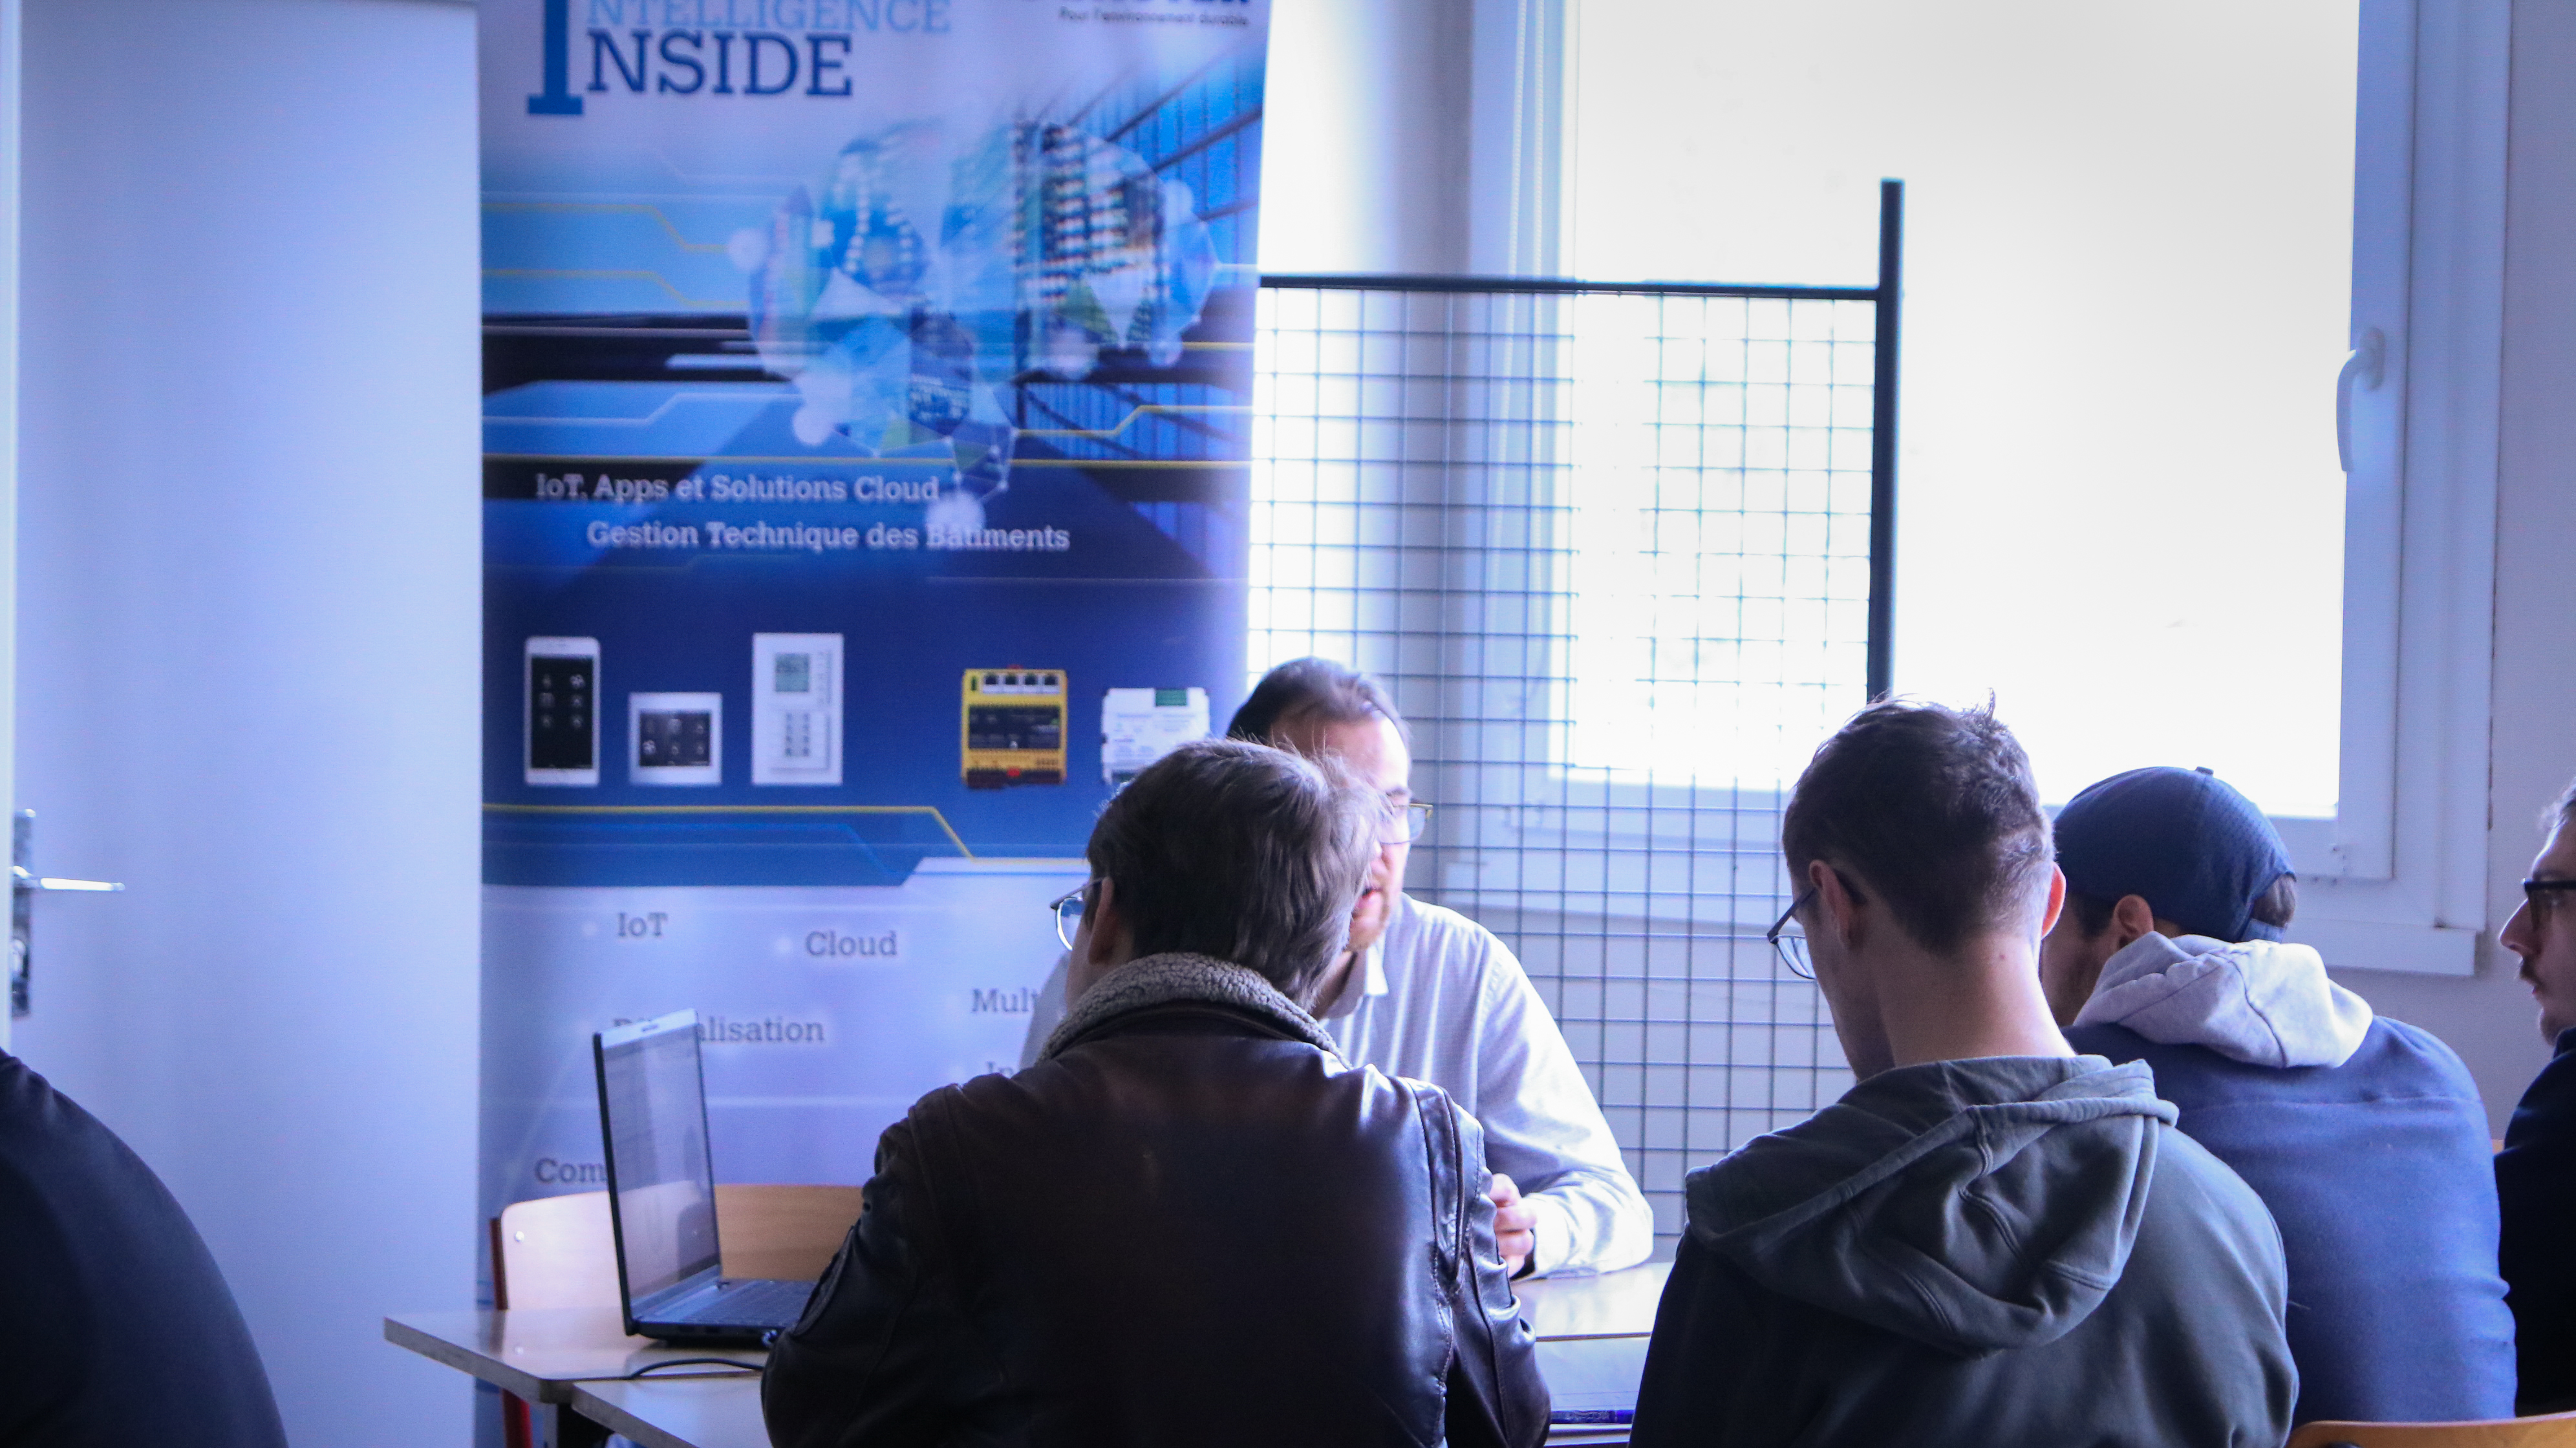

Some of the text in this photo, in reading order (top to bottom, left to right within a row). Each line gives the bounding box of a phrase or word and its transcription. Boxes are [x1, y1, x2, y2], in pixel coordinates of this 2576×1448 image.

[593, 473, 669, 506] Apps
[676, 475, 706, 502] et
[711, 474, 848, 502] Solutions
[853, 476, 939, 503] Cloud
[586, 520, 699, 548] Gestion
[705, 521, 860, 554] Technique
[866, 523, 919, 549] des
[616, 912, 669, 939] IoT
[805, 930, 898, 957] Cloud
